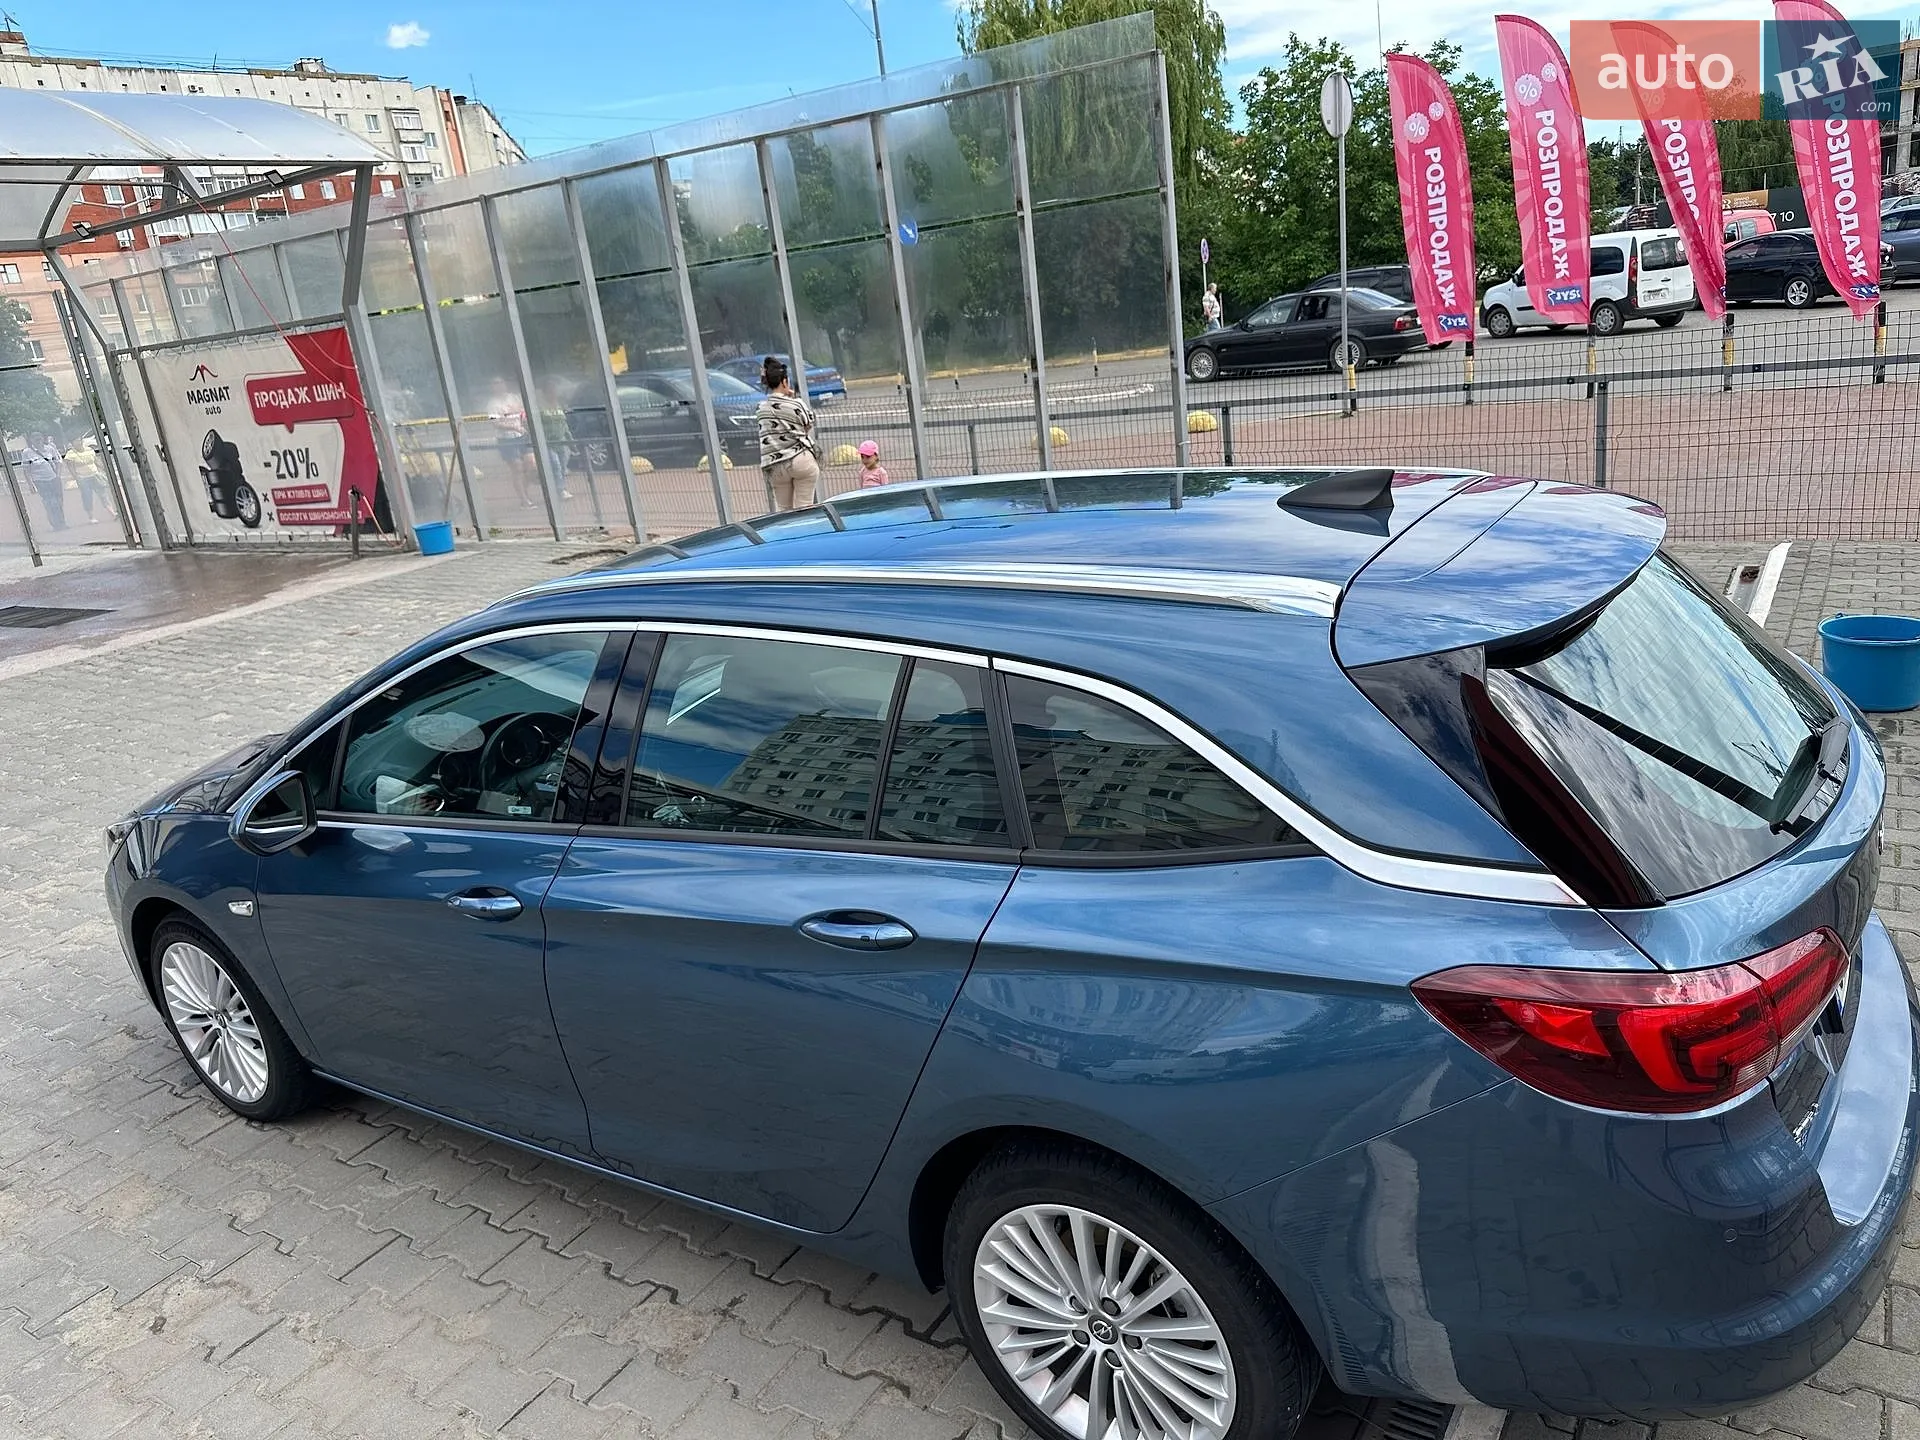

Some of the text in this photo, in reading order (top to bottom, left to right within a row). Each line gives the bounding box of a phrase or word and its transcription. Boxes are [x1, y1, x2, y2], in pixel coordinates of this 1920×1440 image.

[1535, 109, 1570, 280] РОЗПРОДАЖ
[1823, 93, 1868, 279] РОЗПРОДАЖ
[1424, 146, 1457, 308] РОЗПРОДАЖ
[186, 386, 231, 405] MAGNAT
[205, 406, 222, 415] auto
[254, 382, 347, 409] ПРОДАЖ ШИН
[264, 447, 319, 480] -20%
